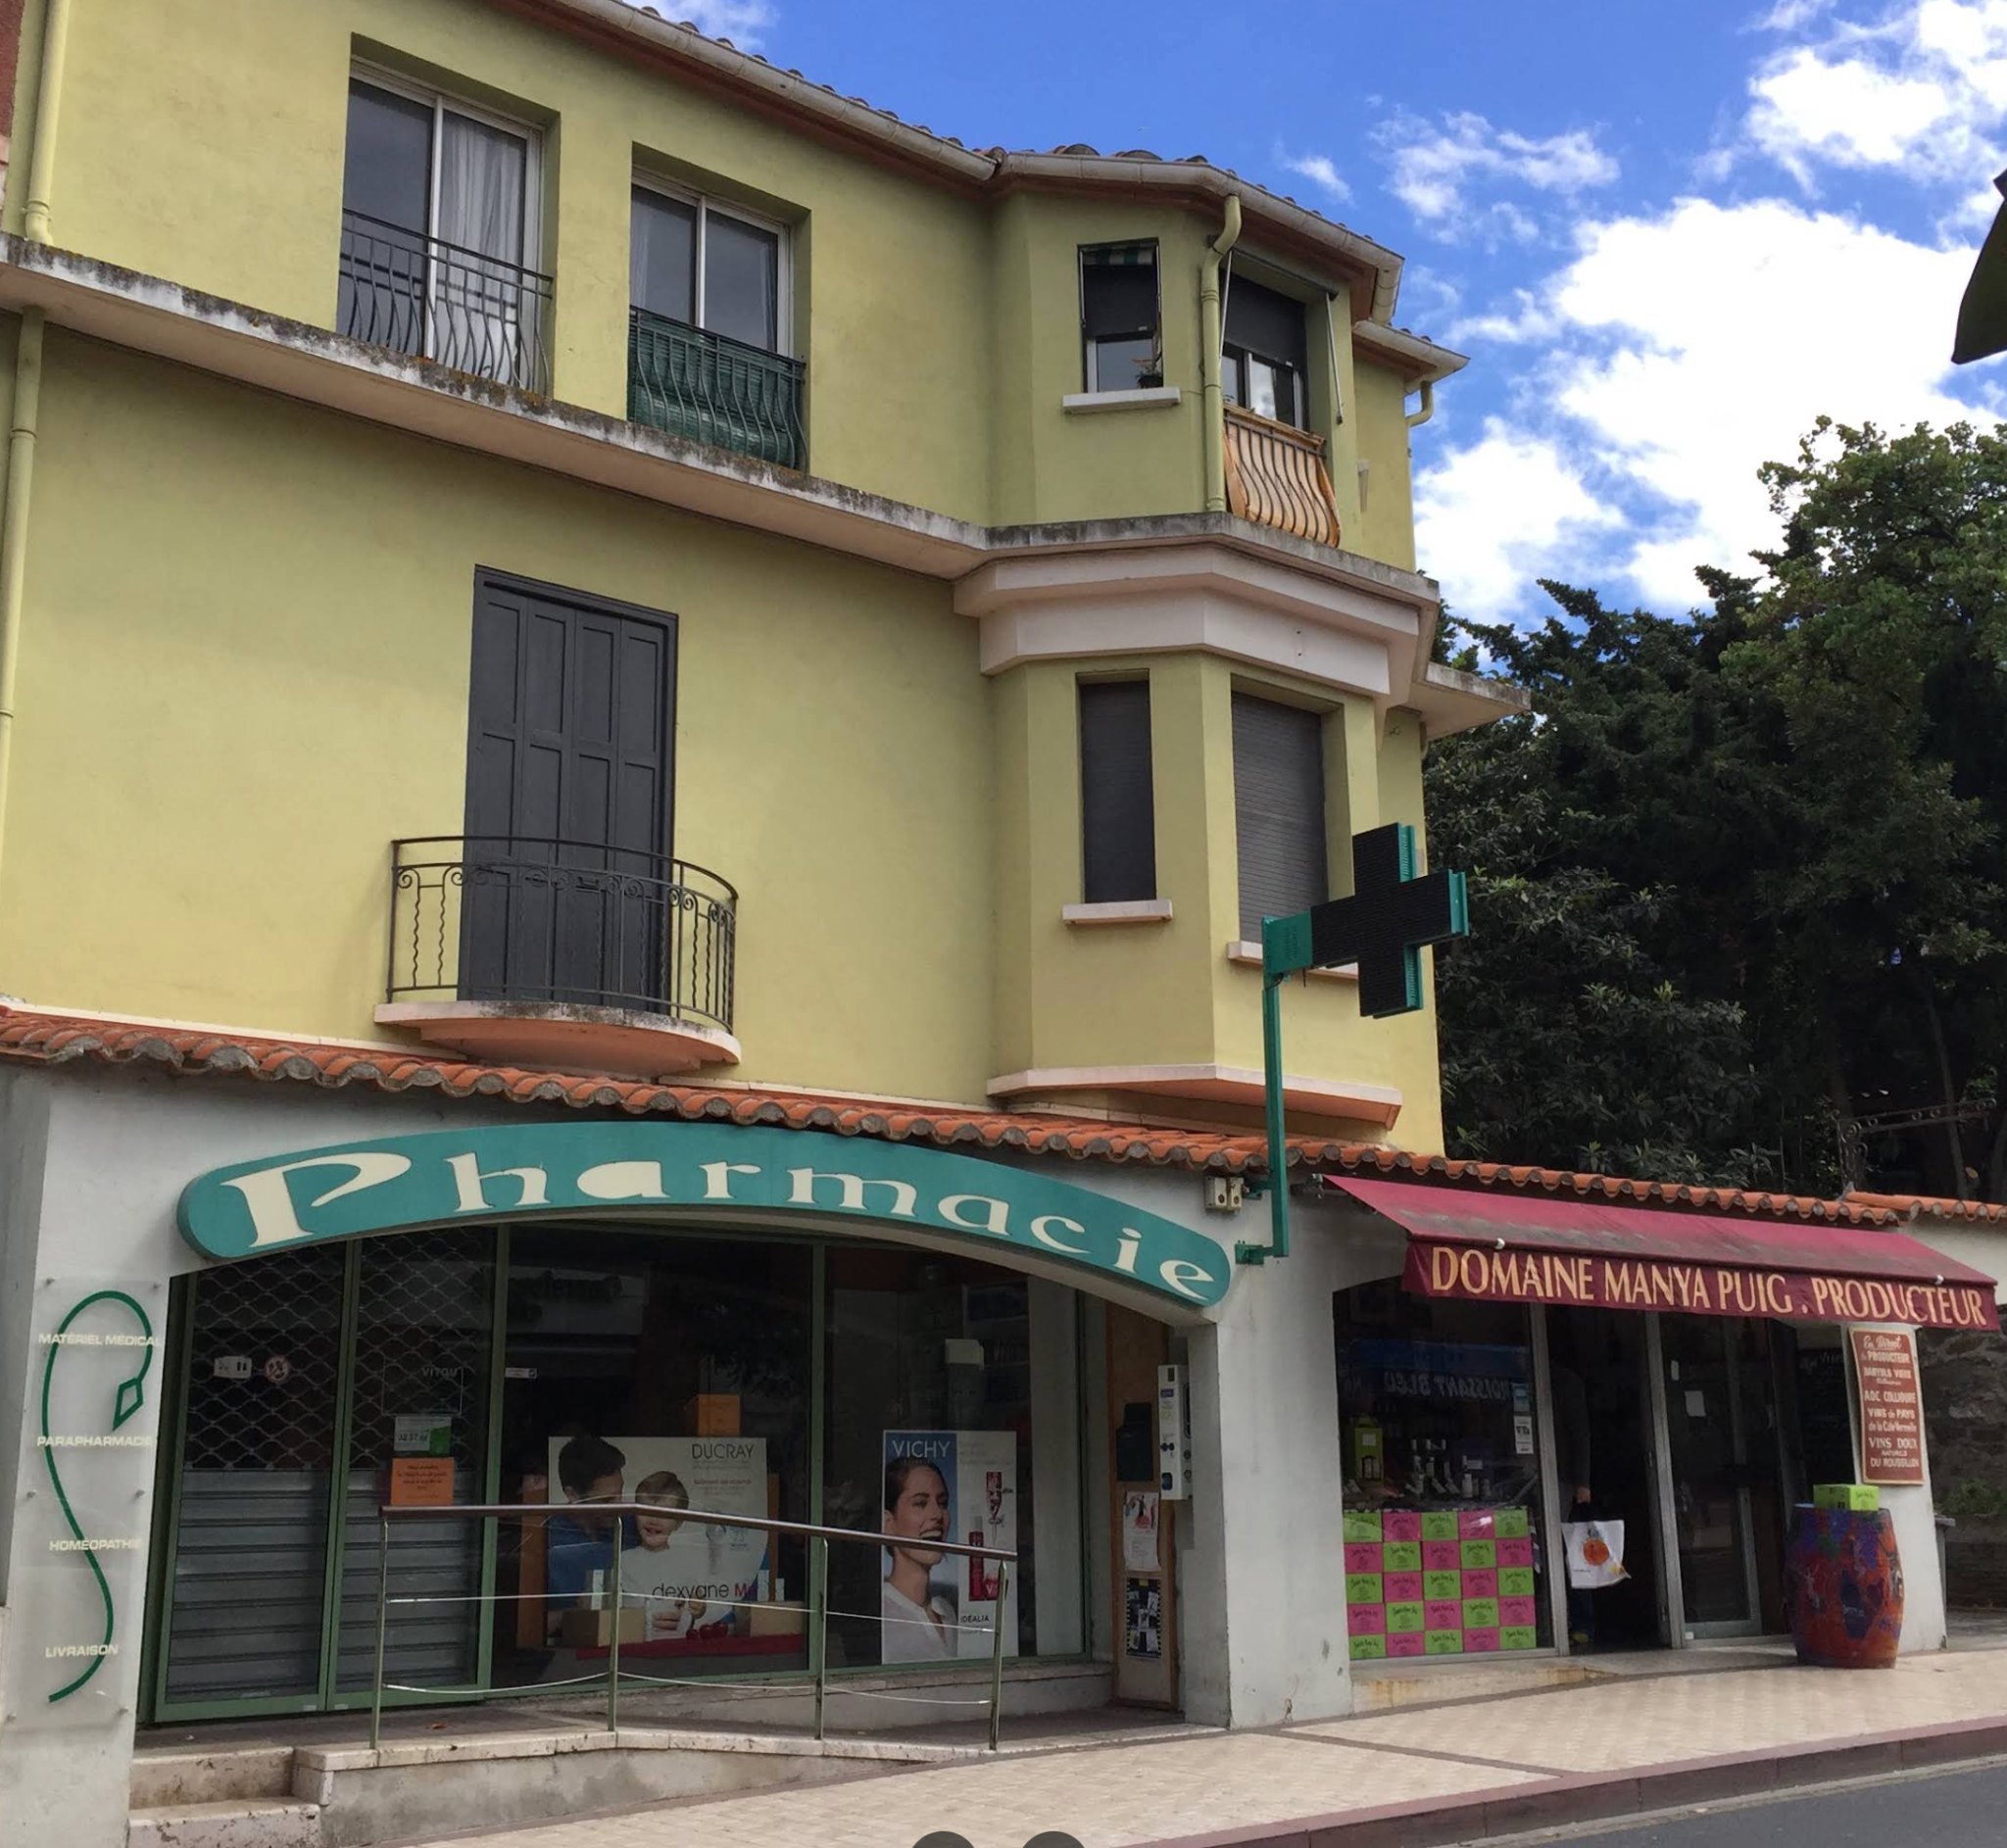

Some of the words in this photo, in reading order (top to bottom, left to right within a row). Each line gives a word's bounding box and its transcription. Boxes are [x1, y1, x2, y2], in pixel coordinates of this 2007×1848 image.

[220, 1149, 1216, 1300] Pharmacie
[1431, 1246, 1595, 1301] DOMAINE
[1604, 1259, 1712, 1309] MANYA
[1717, 1270, 1792, 1314] PUIG
[1811, 1277, 1987, 1327] PRODUCTEUR
[37, 1435, 155, 1447] PARAPHARMACIE
[892, 1440, 950, 1458] VICHY
[1868, 1437, 1892, 1449] VINS
[692, 1443, 754, 1459] DUCRAY
[652, 1582, 729, 1600] dexyane
[45, 1644, 118, 1657] LIVRAISON
